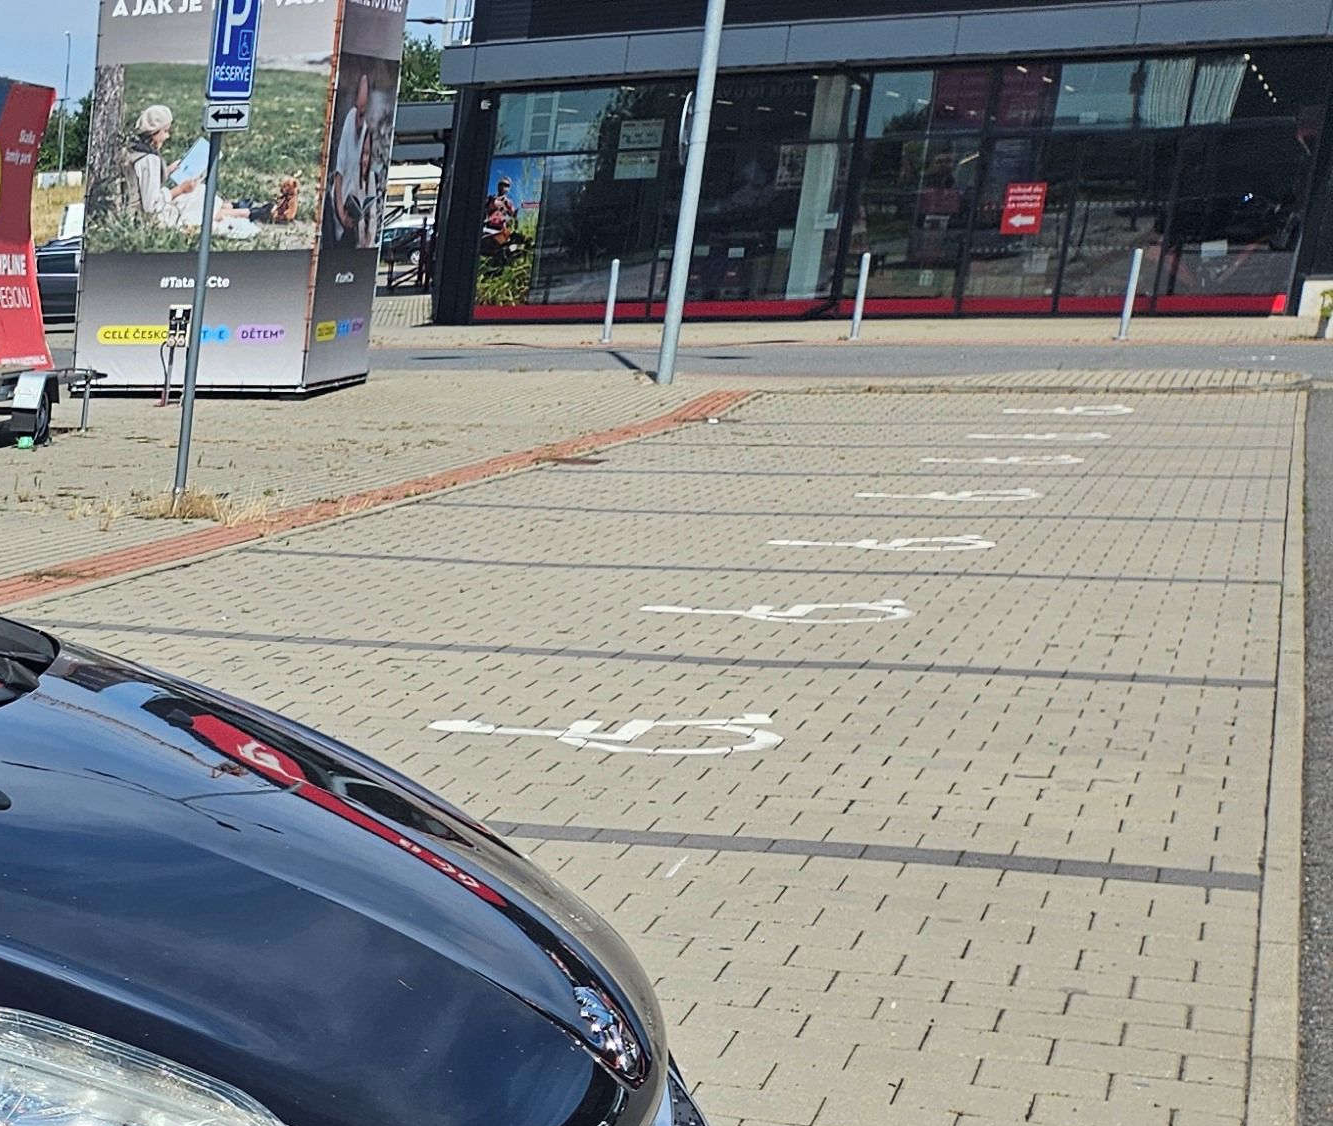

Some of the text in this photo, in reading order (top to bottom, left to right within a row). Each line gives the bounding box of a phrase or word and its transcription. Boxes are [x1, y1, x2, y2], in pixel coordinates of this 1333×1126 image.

[222, 0, 252, 55] P
[214, 62, 251, 82] RÉSERVÉ
[104, 327, 130, 340] CELÉ
